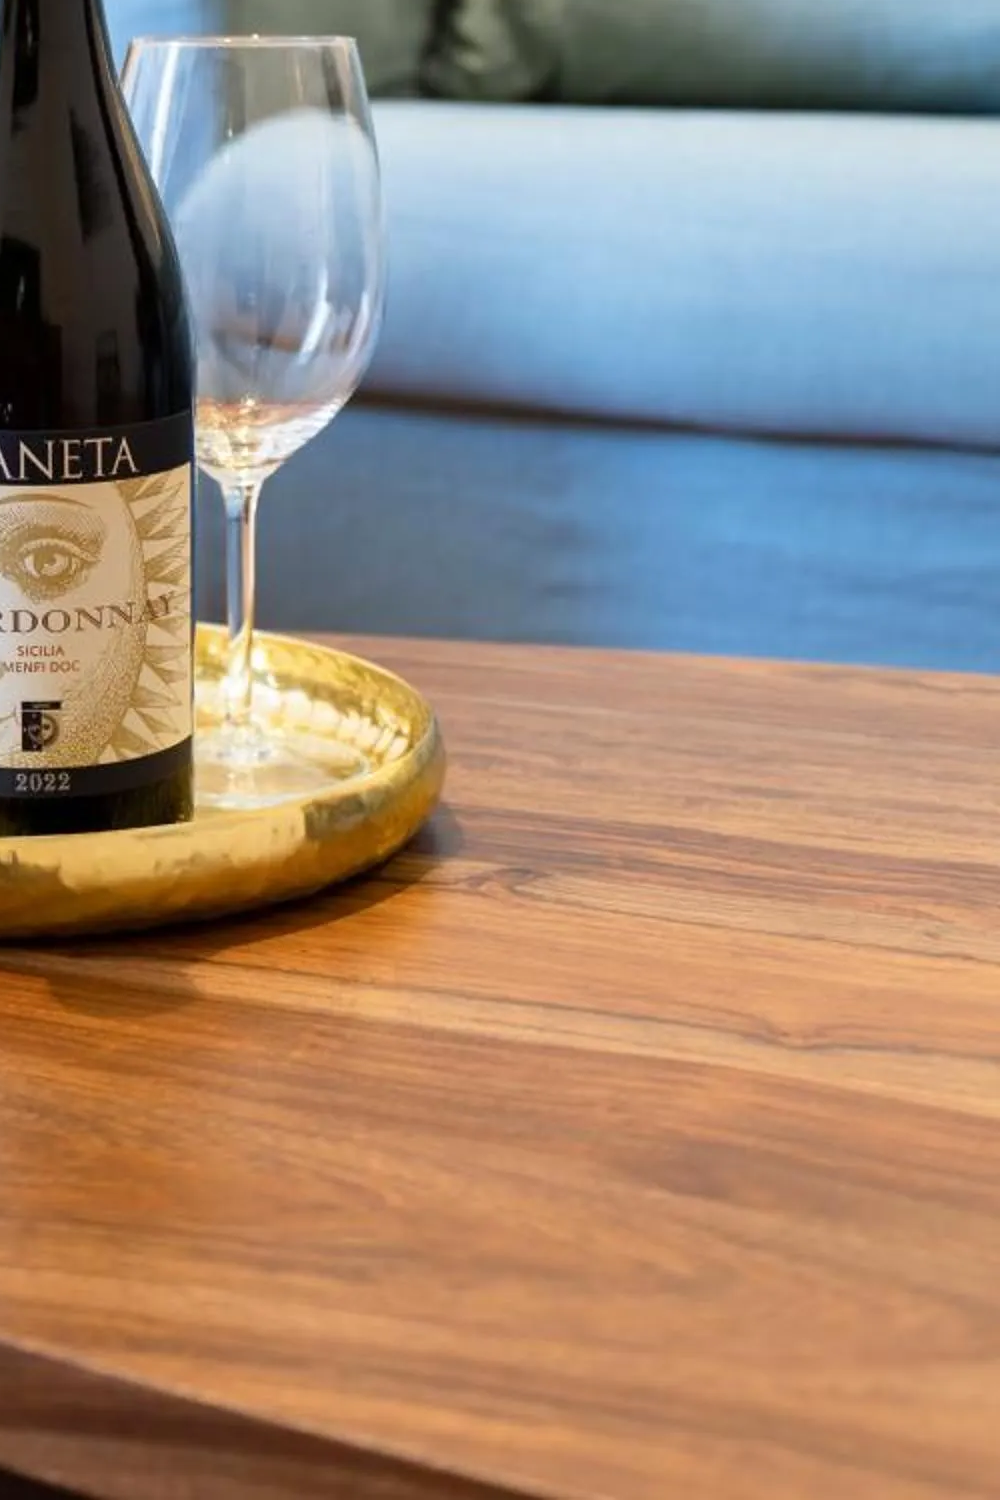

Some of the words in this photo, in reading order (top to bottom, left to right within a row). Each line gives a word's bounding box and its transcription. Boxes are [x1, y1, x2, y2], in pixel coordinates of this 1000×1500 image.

[16, 644, 65, 657] SICILIA
[2, 660, 45, 673] MENFI
[50, 660, 80, 673] DOC
[14, 772, 71, 792] 2022
